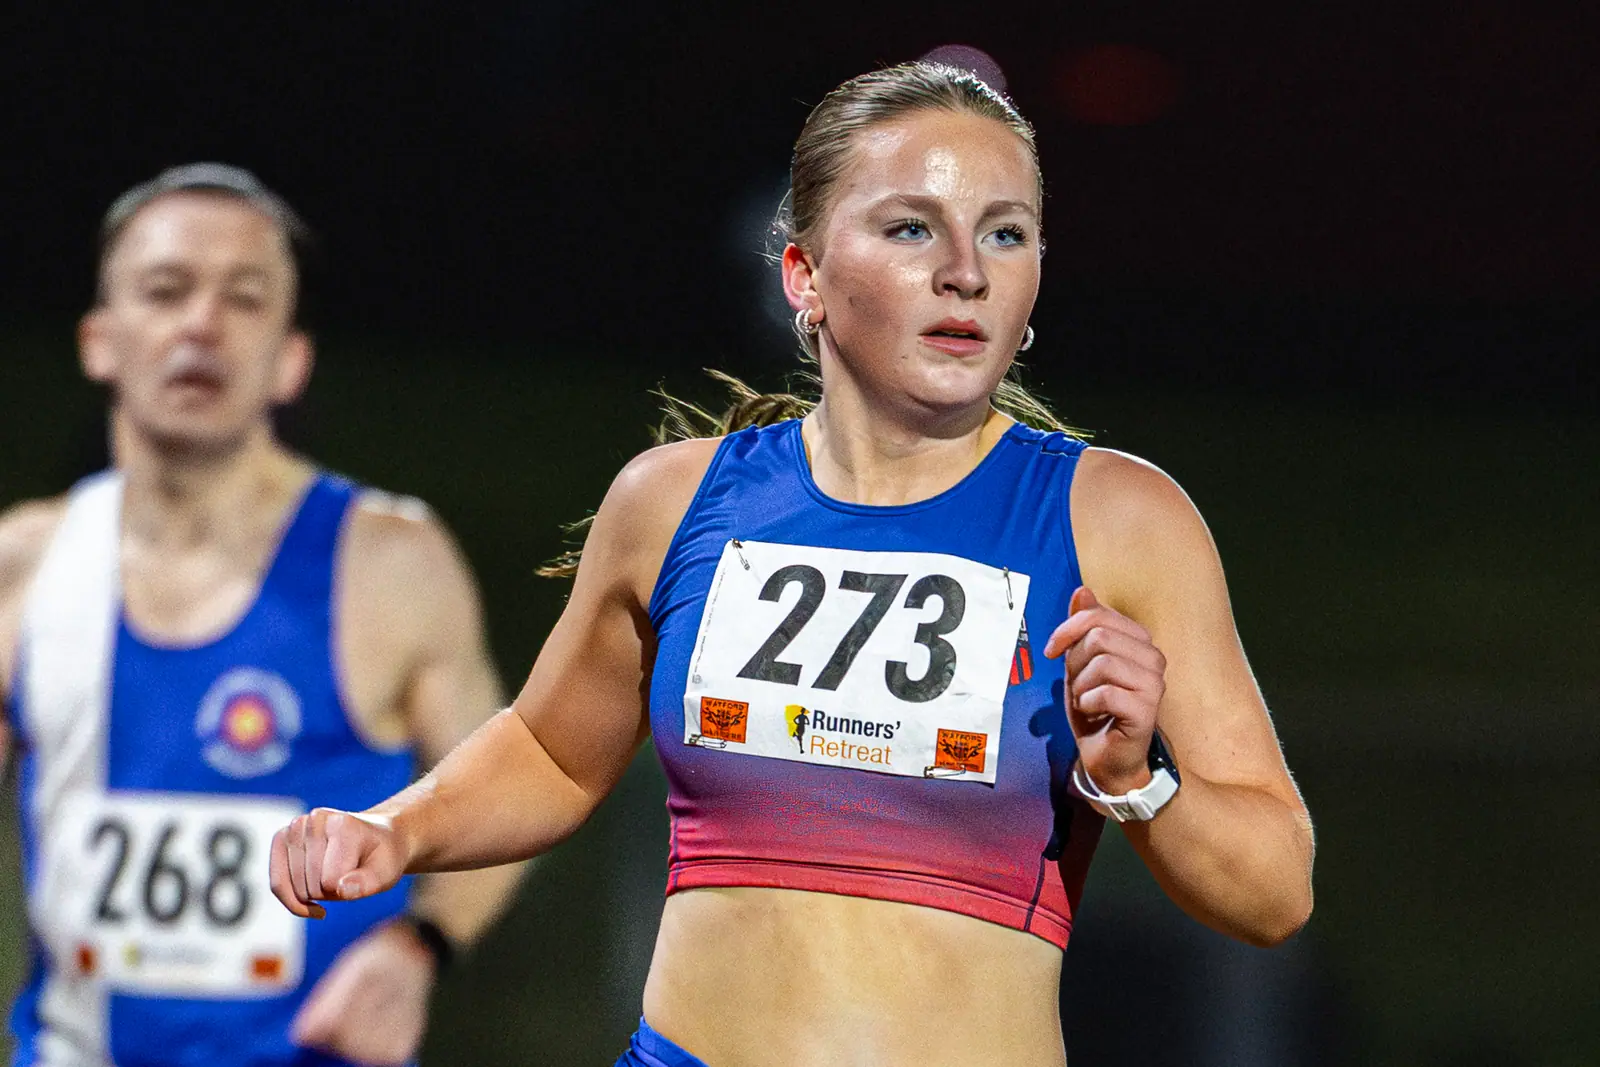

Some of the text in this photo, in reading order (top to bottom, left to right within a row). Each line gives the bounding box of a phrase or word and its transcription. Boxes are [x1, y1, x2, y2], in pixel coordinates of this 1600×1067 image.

[736, 564, 966, 703] 273
[810, 735, 892, 765] Retreat
[87, 817, 252, 929] 268
